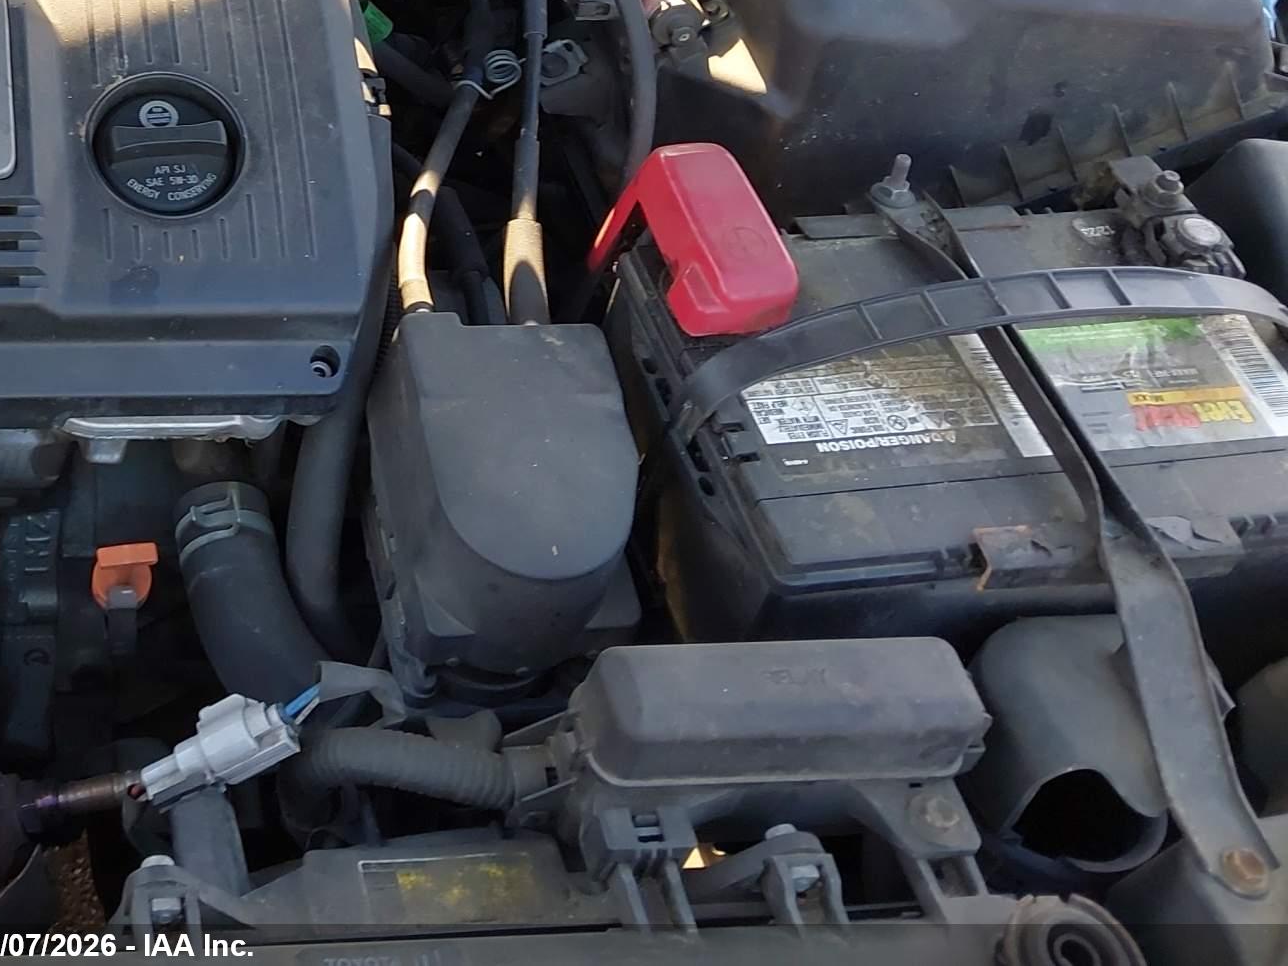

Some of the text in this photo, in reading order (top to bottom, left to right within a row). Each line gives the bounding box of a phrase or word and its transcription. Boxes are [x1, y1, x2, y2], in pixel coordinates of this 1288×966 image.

[154, 164, 187, 175] API SJ
[126, 172, 217, 202] ENERGY CONSERVING
[145, 174, 199, 188] SAE 5W-30
[815, 433, 944, 453] DANGER/POISON
